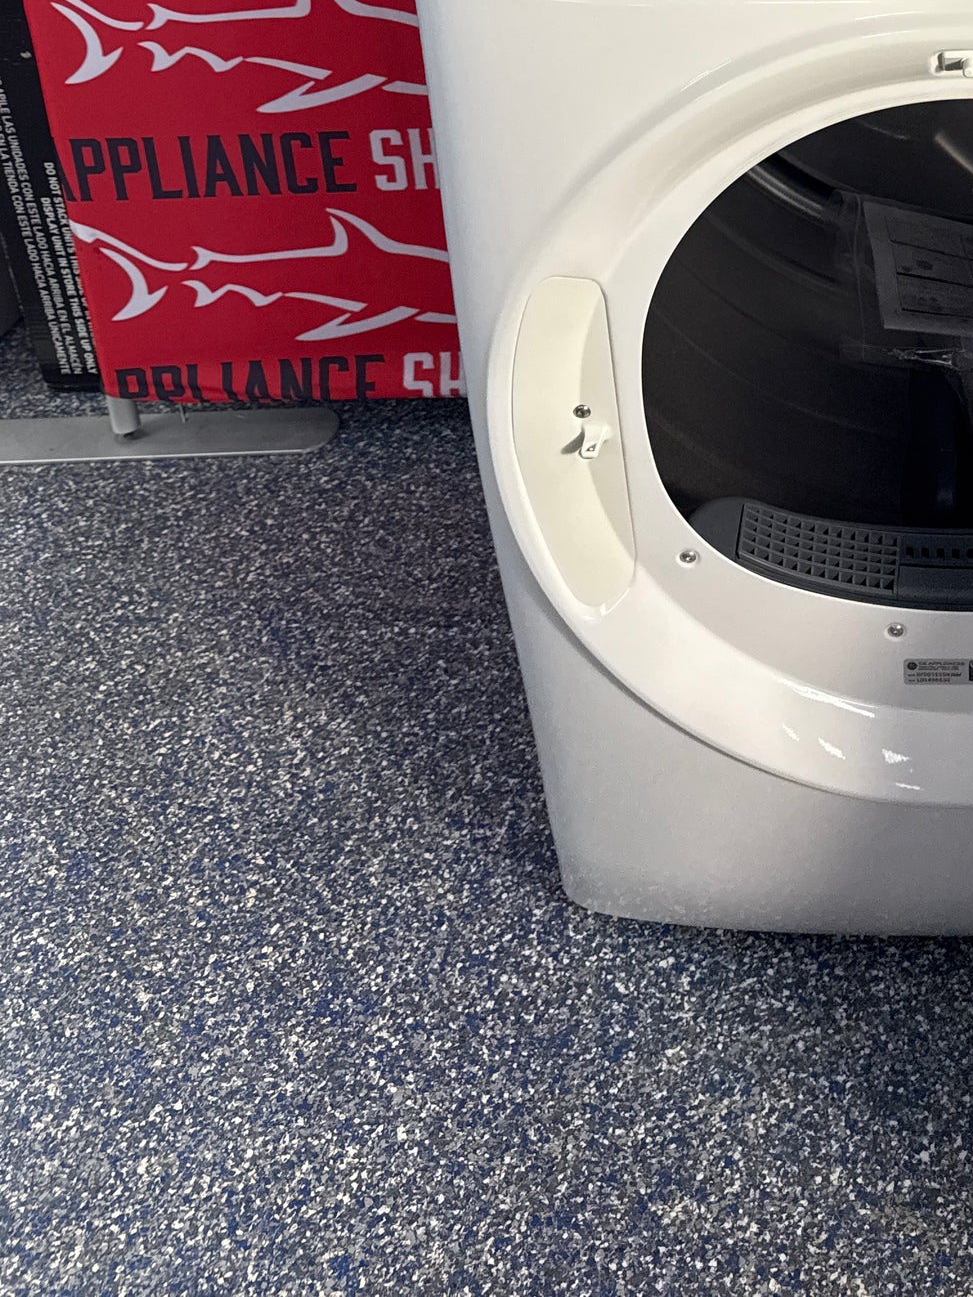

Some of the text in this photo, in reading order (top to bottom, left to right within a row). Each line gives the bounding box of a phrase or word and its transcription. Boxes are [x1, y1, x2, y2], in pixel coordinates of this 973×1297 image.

[8, 135, 30, 182] UNIDADES
[43, 161, 57, 176] DO
[20, 182, 35, 202] CON
[47, 176, 62, 196] NOT
[11, 194, 26, 215] CON
[26, 202, 42, 226] ESTE
[40, 196, 60, 235] DISPLAY
[53, 196, 70, 226] STACK
[17, 214, 33, 238] ESTE
[32, 225, 49, 251] LADO
[51, 234, 67, 257] UNIT
[23, 238, 40, 263] LADO
[56, 257, 70, 269] IN
[60, 268, 78, 297] STORE
[69, 297, 83, 319] THIS
[74, 318, 90, 339] SIDE
[80, 339, 93, 352] UP
[83, 352, 99, 376] ONLY
